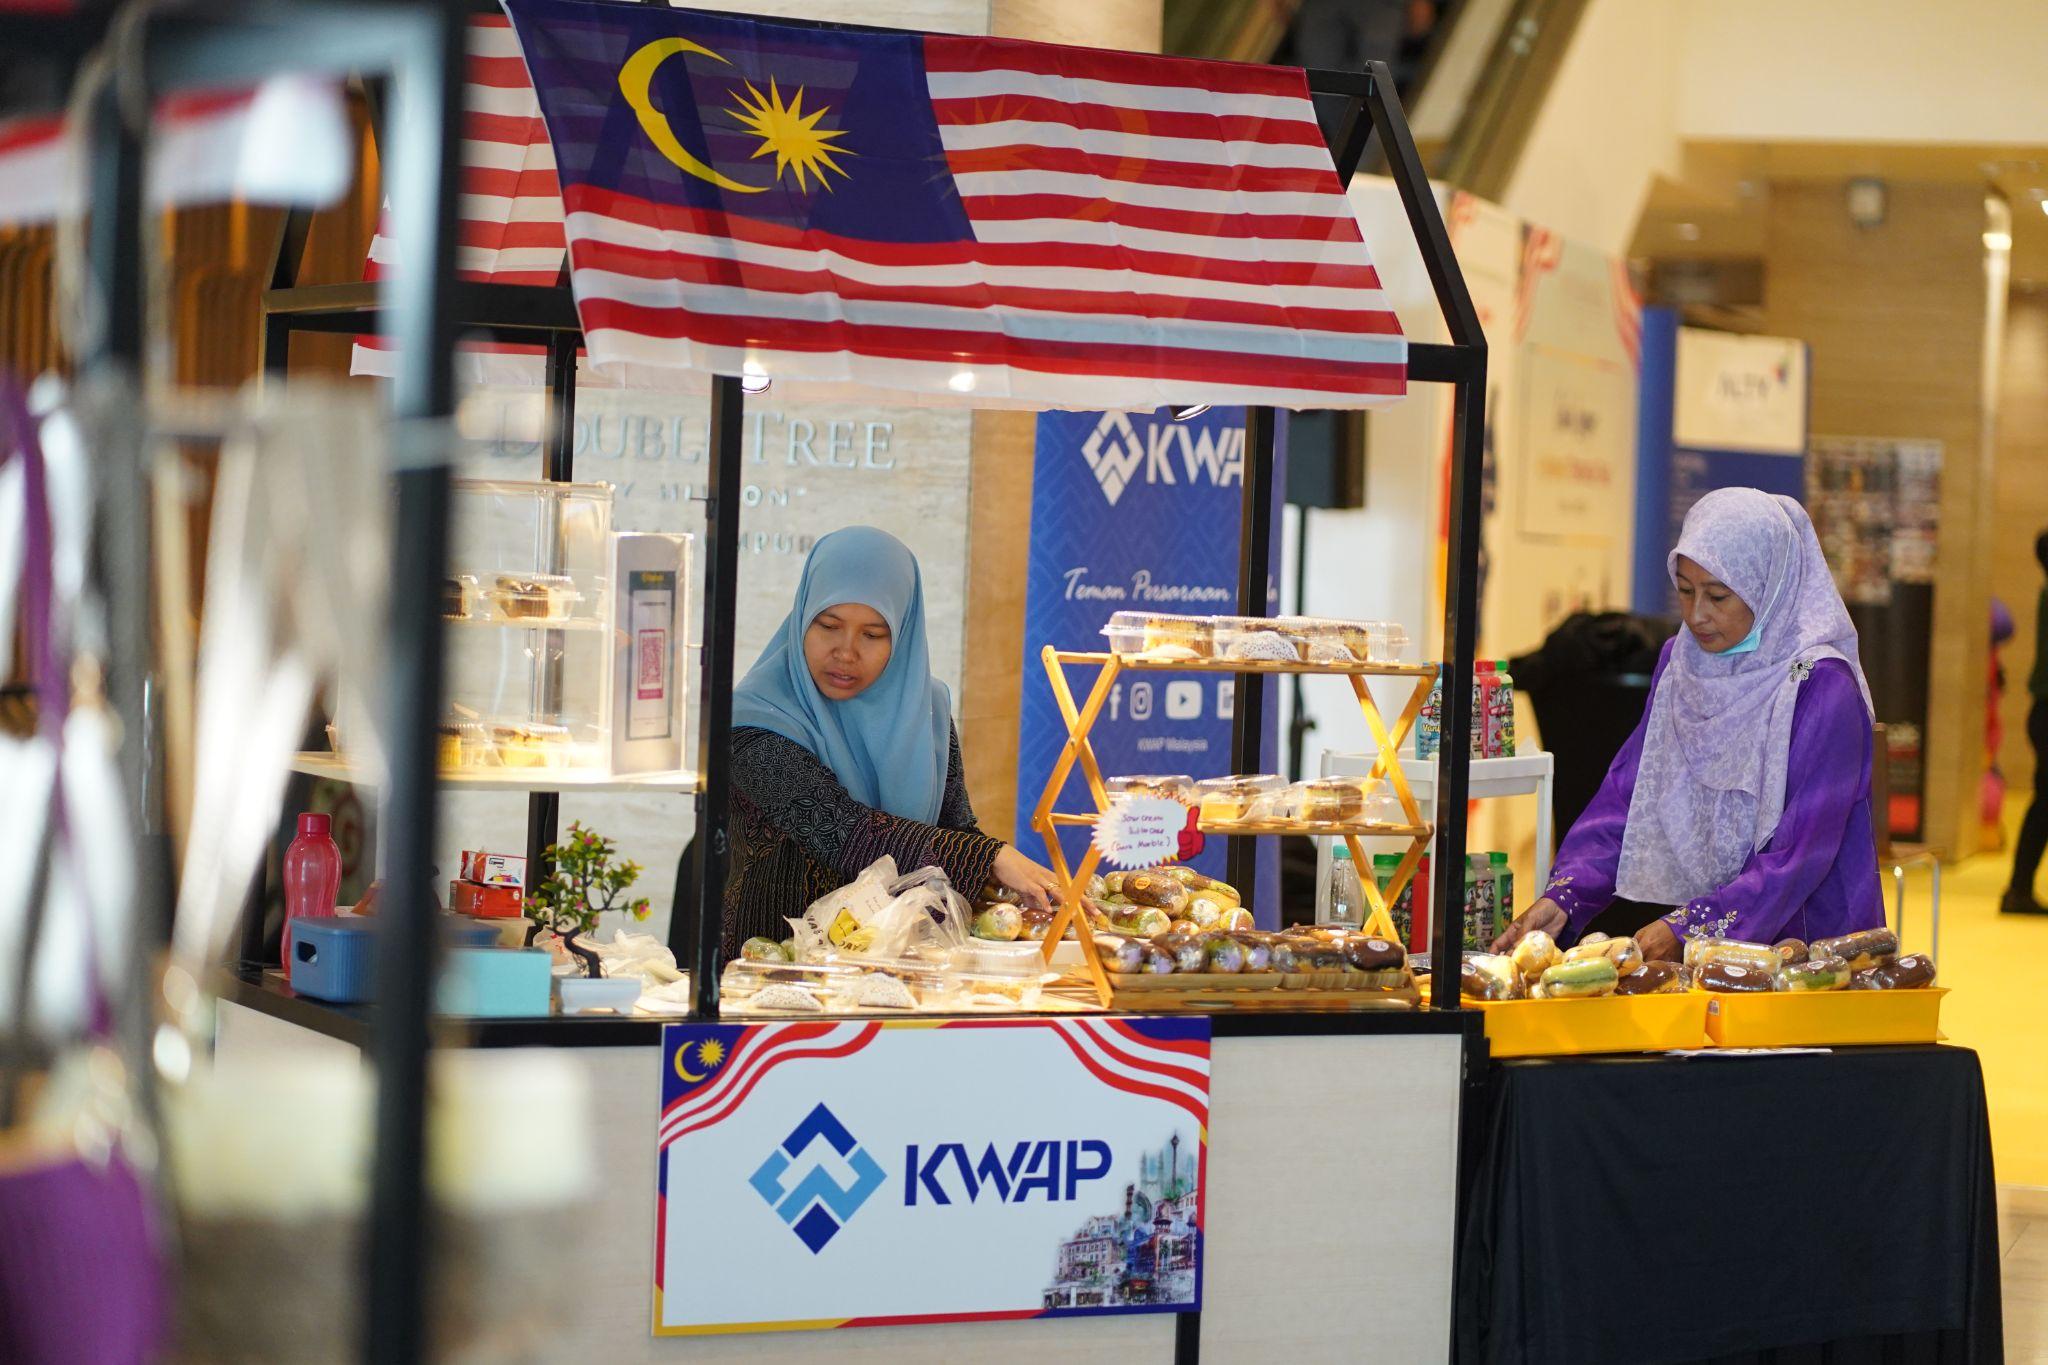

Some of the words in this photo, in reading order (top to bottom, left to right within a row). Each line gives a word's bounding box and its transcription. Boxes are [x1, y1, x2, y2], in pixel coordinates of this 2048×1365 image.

[1146, 423, 1246, 488] KWA
[1064, 567, 1127, 600] Teman
[904, 1138, 1112, 1207] KWAP
